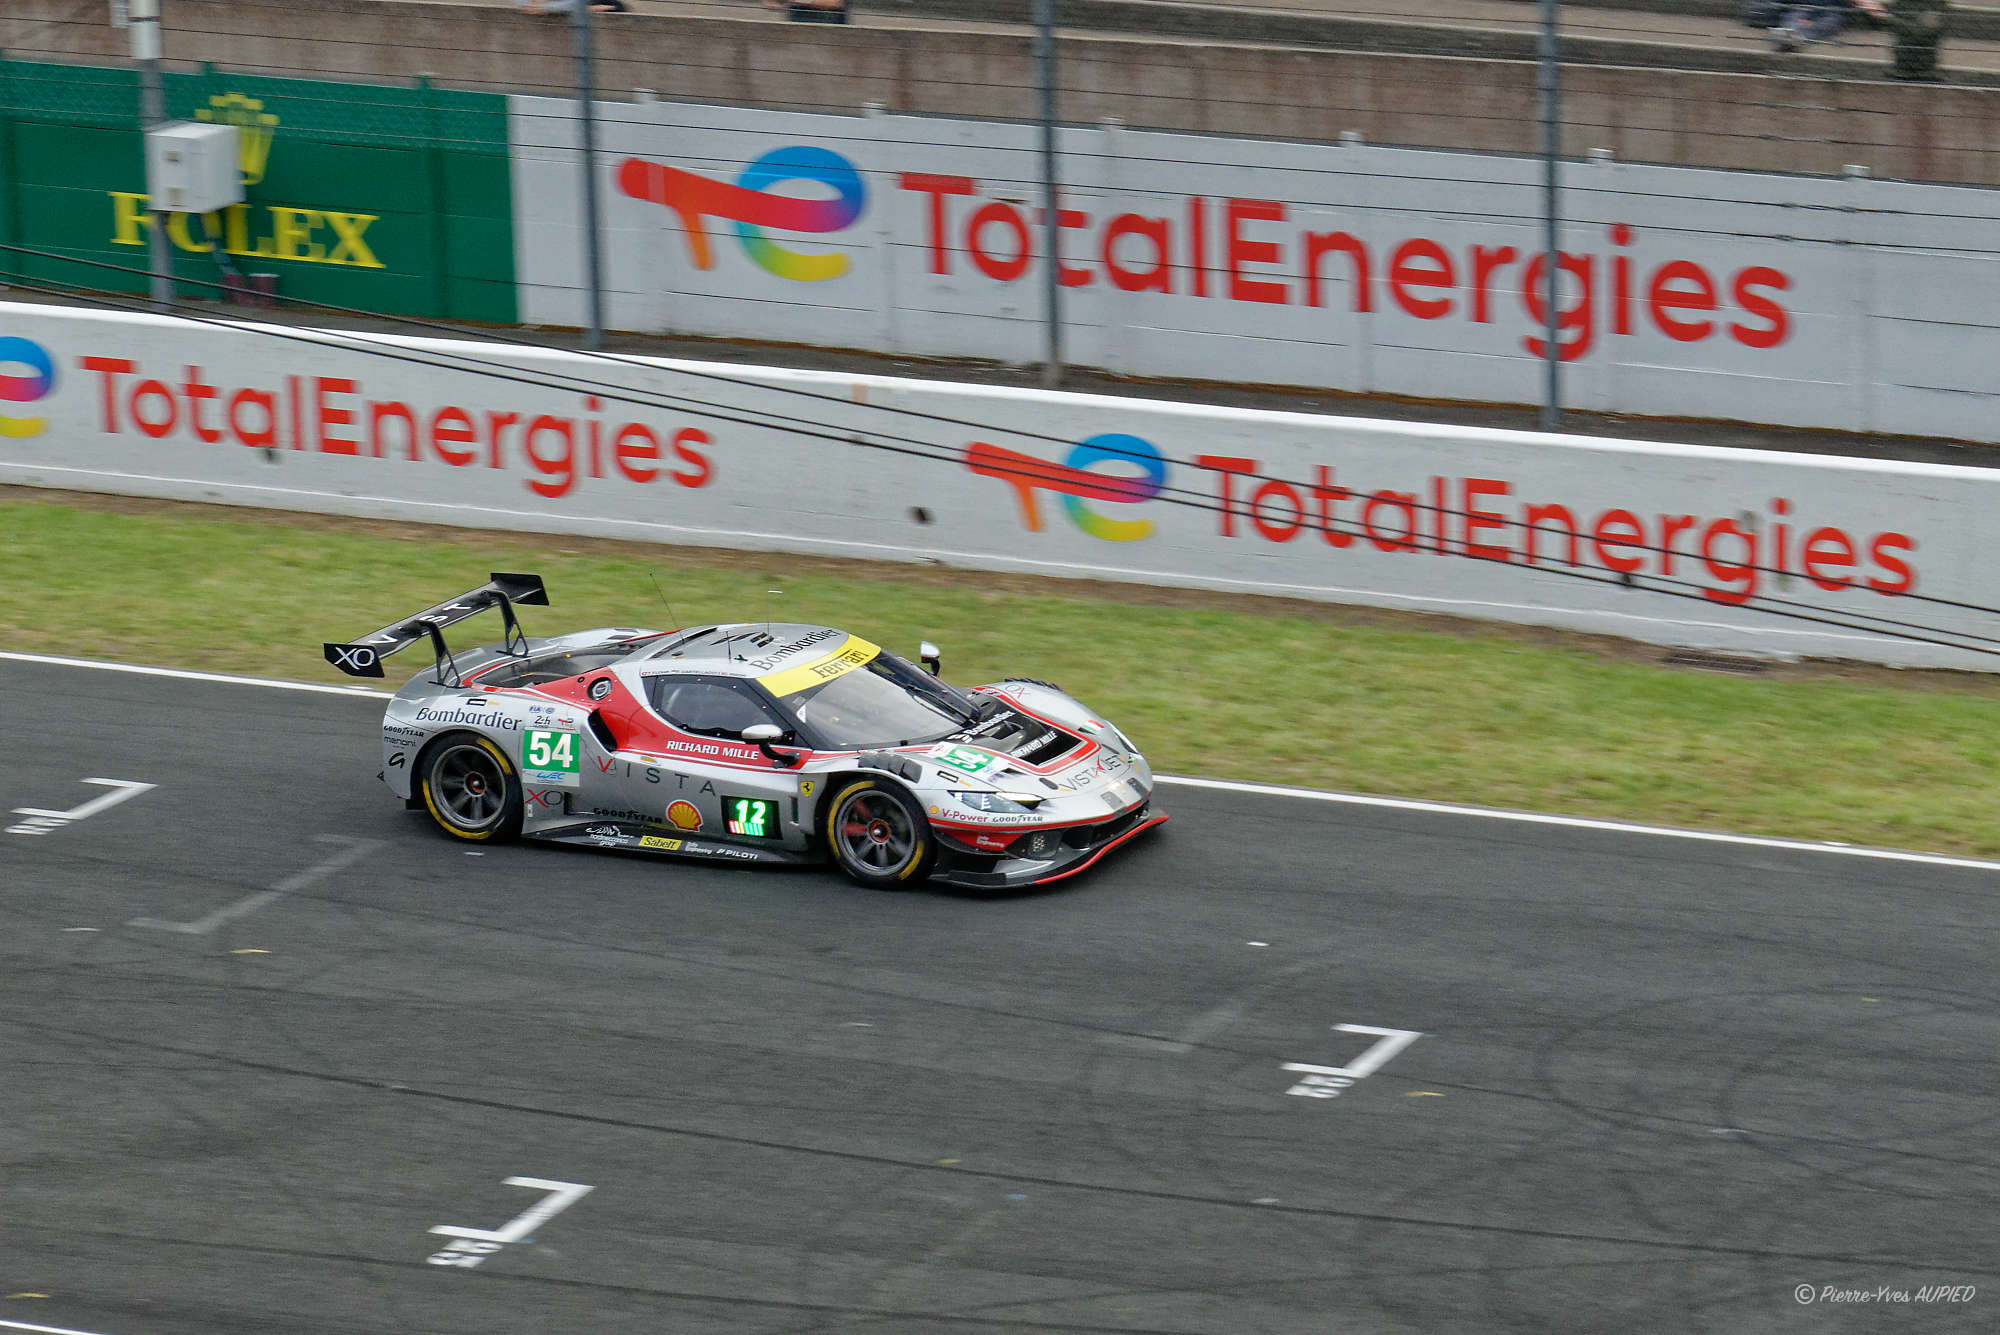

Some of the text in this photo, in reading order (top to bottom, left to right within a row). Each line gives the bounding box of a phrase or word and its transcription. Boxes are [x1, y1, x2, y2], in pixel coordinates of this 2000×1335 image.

[898, 171, 1793, 362] TotalEnergies
[80, 356, 717, 498] TotalEnergies
[1195, 455, 1919, 607] TotalEnergies
[333, 646, 376, 670] XO
[750, 628, 842, 671] Bombardier
[808, 648, 870, 679] Ferrari
[416, 707, 523, 731] Bombardier
[529, 730, 574, 769] 54
[666, 740, 759, 760] RICHARD MILLE
[597, 756, 716, 797] VISTA
[734, 799, 767, 825] 12
[941, 808, 988, 823] V-Power
[992, 814, 1044, 823] GOODYEAR
